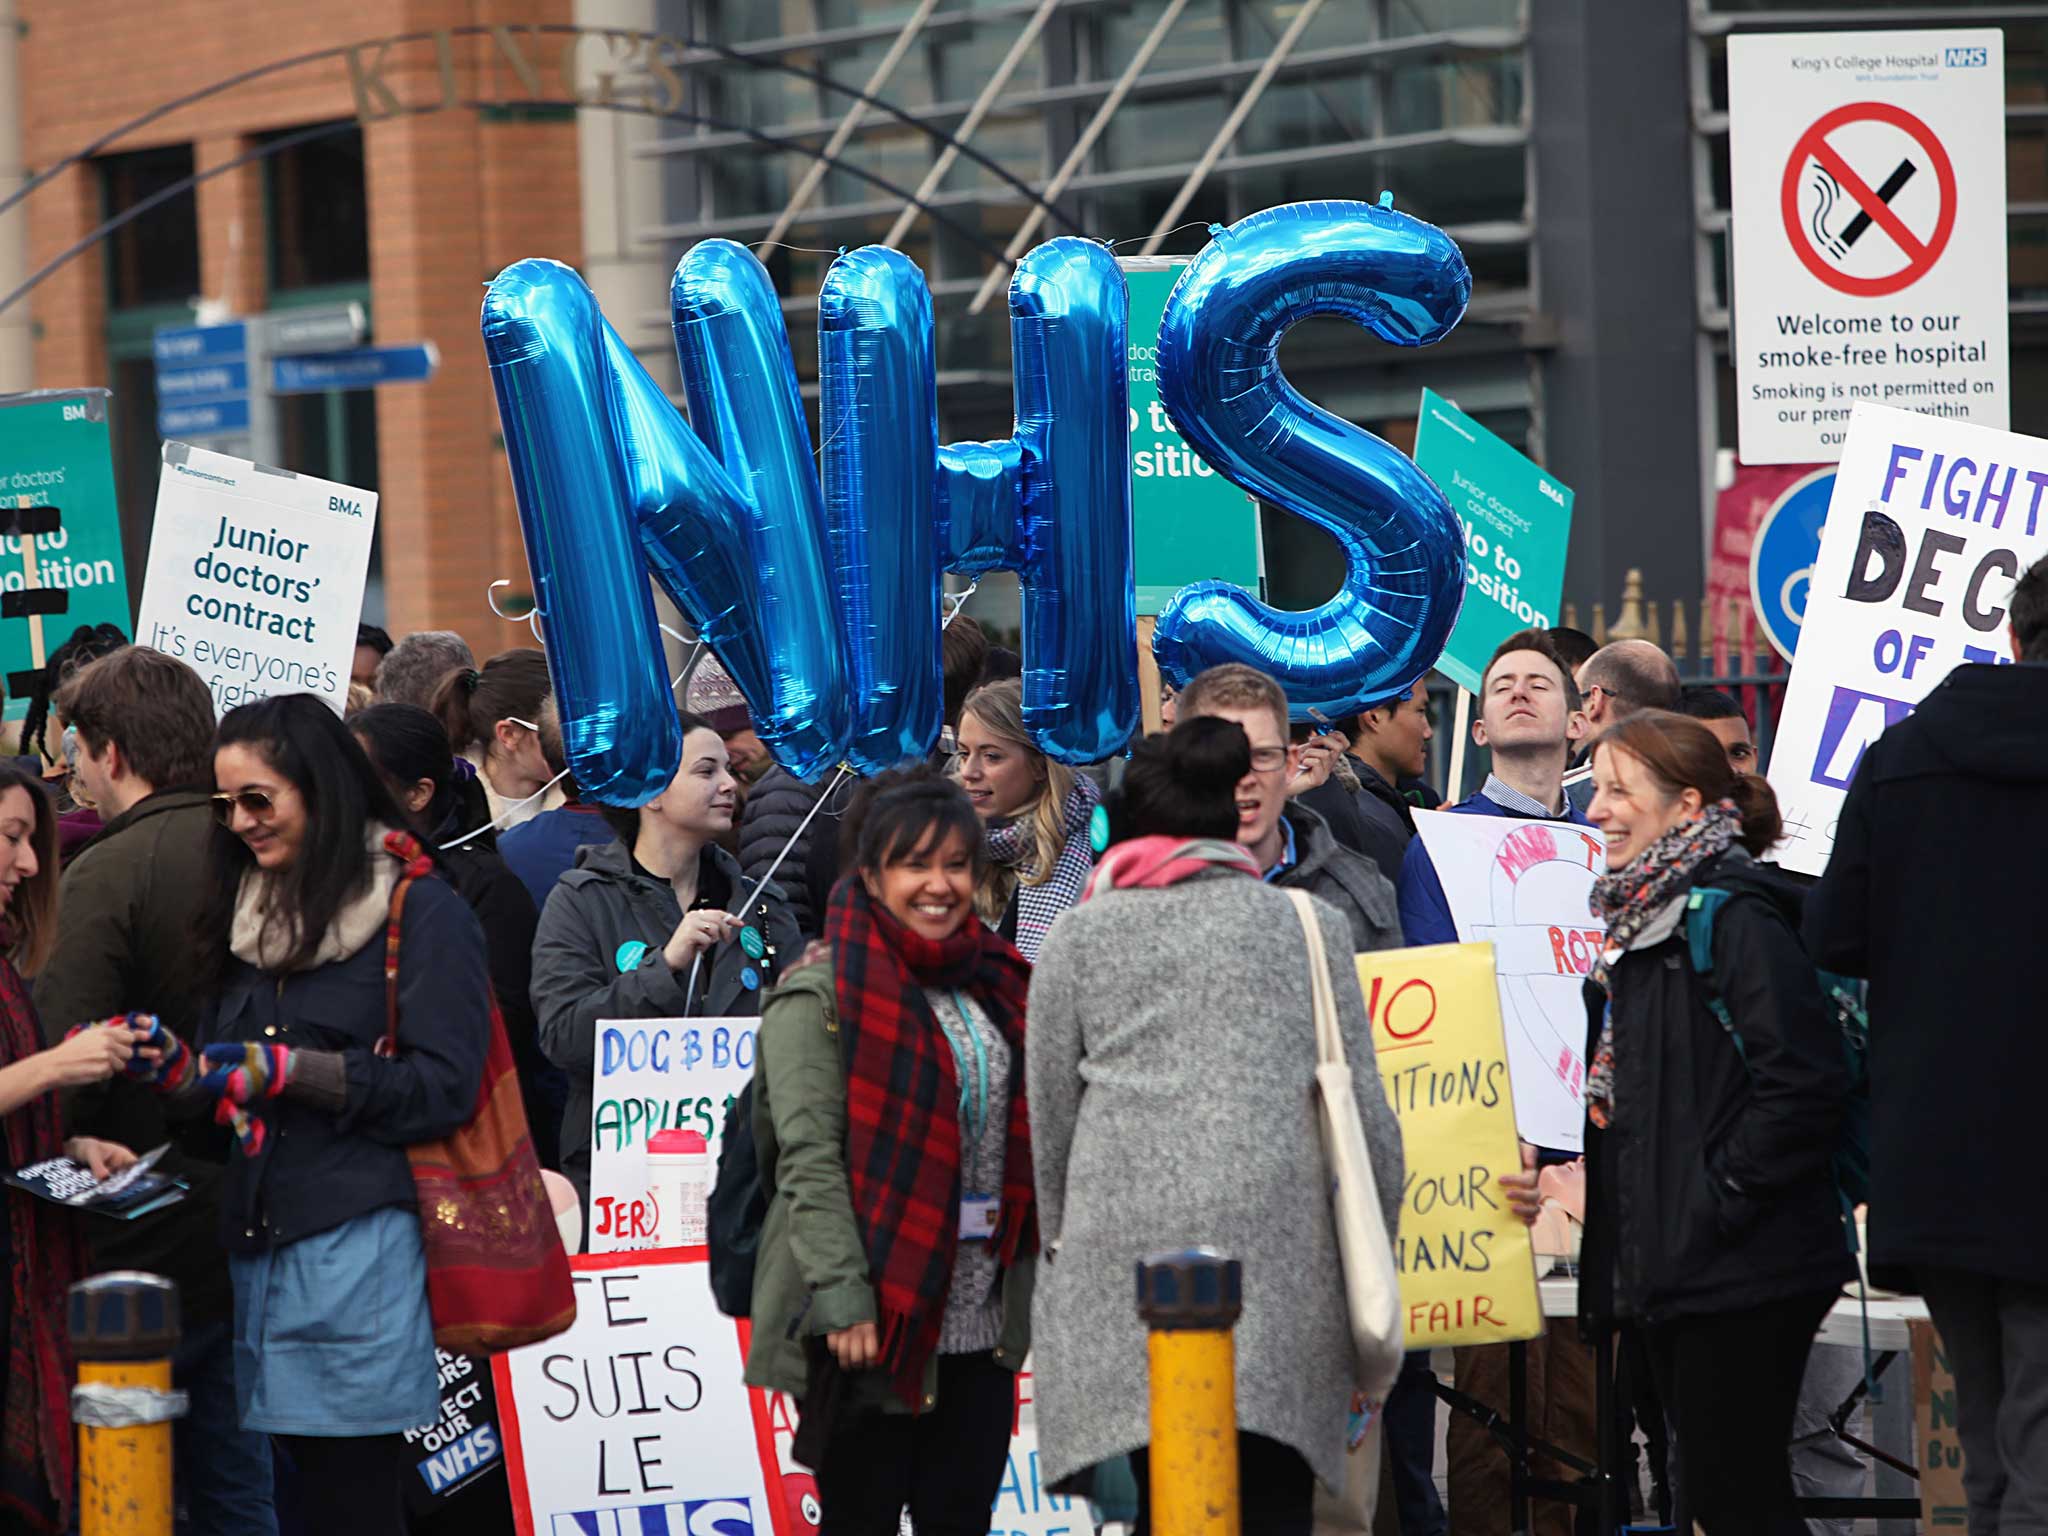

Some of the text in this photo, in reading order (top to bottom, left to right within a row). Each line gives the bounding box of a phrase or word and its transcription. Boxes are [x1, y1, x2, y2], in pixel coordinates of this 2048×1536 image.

[1791, 53, 1939, 73] King's College Hospital
[1945, 48, 1987, 67] NHS
[1777, 314, 1960, 335] Welcome to our
[1758, 340, 1987, 368] smoke-free hospital
[1752, 378, 1994, 402] Smoking is not permitted on
[1778, 410, 1805, 423] our
[481, 190, 1473, 806] NHS
[1452, 469, 1487, 501] Junior
[1538, 479, 1565, 508] BMA
[328, 496, 363, 518] BMA
[1467, 499, 1513, 539] contract
[213, 516, 310, 563] Junior
[1494, 544, 1521, 580] to
[186, 593, 316, 643] contract
[1873, 629, 1935, 680] OF
[602, 1028, 670, 1076] DOG
[1410, 1296, 1507, 1334] FAIR
[541, 1345, 703, 1421] SUIS
[423, 1413, 472, 1452] OUR
[425, 1425, 498, 1491] NHS
[598, 1436, 673, 1496] LE
